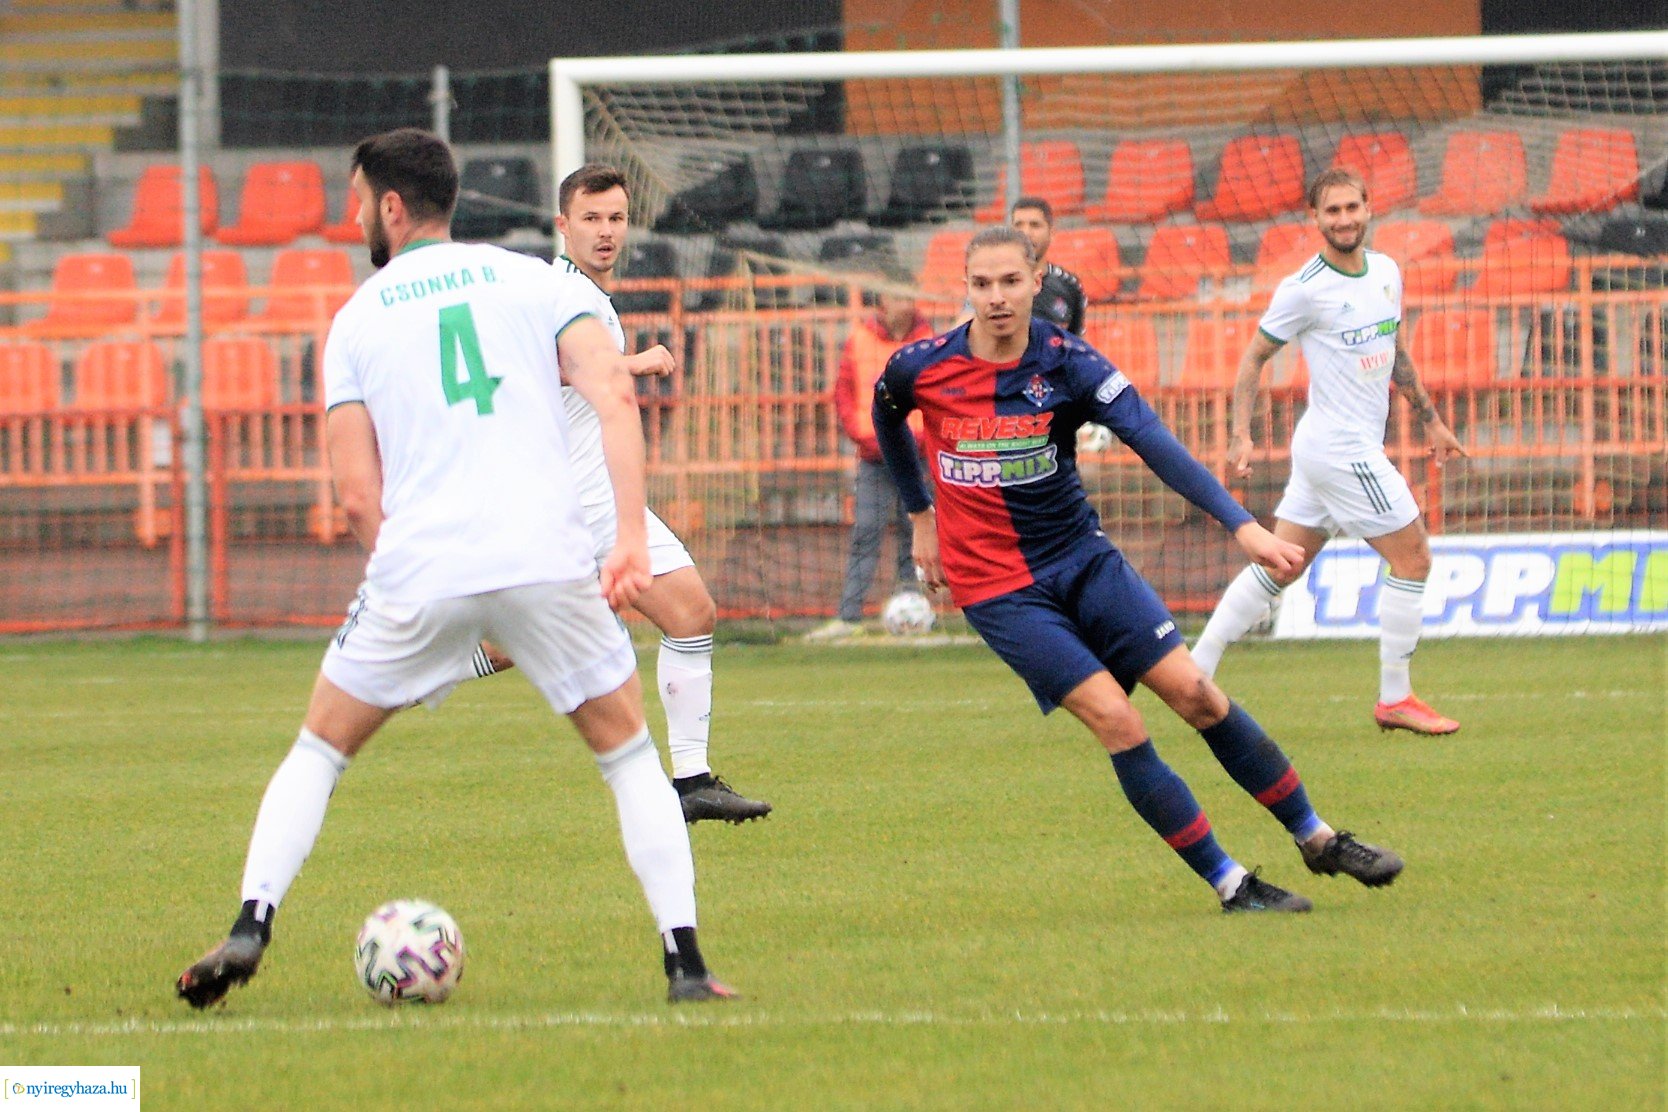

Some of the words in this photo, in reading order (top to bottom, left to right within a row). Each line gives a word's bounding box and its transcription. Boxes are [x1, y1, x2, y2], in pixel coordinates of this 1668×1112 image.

[380, 268, 475, 307] CSONKA
[438, 302, 504, 416] 4
[941, 412, 1054, 439] REVESZ
